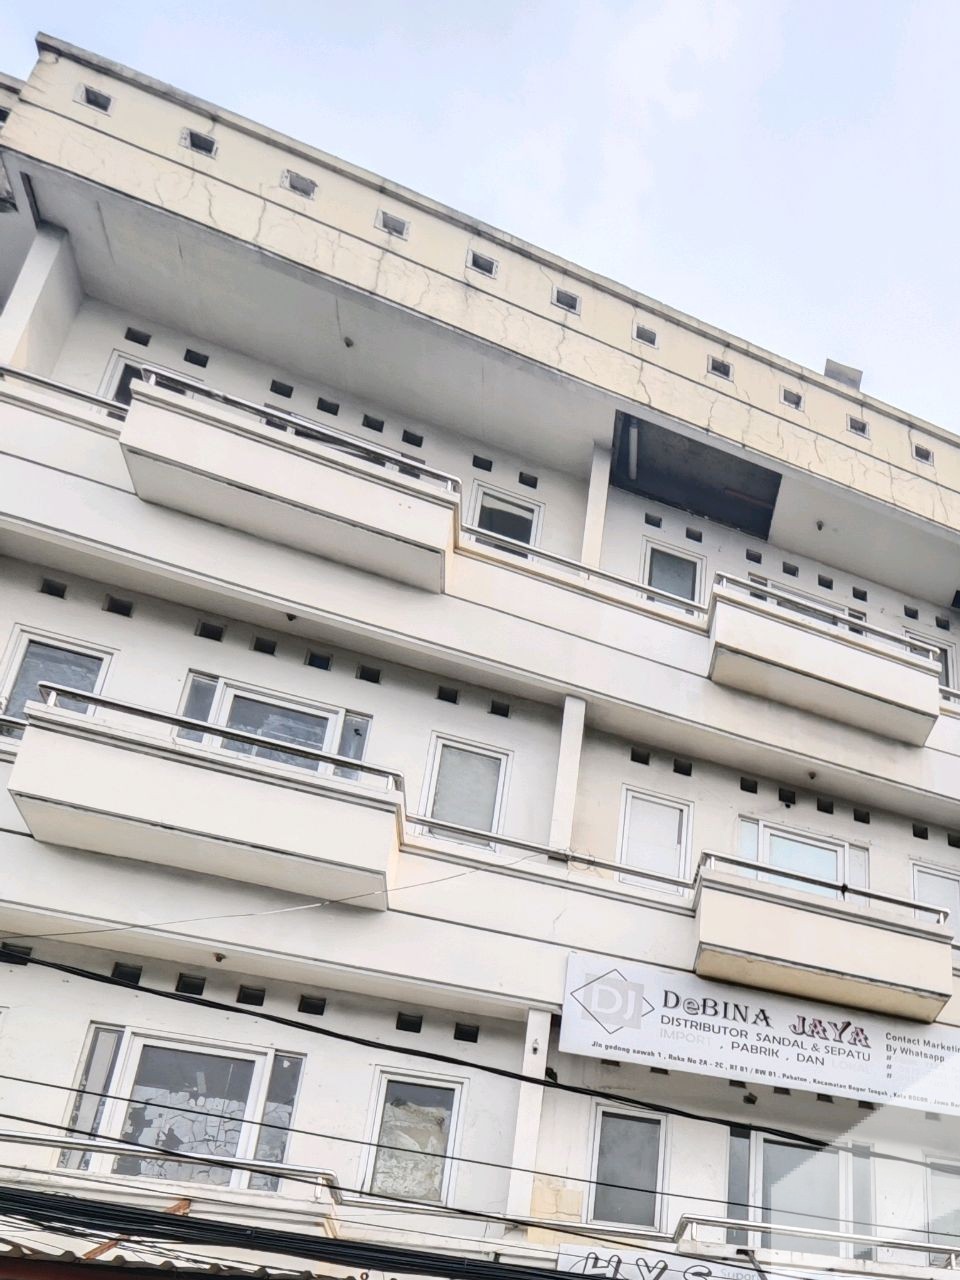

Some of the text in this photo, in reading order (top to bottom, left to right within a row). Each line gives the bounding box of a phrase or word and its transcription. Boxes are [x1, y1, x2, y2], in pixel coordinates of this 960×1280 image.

[660, 1015, 871, 1062] DISTRIBUTOR SANDAL & SEPATU
[788, 1013, 872, 1049] JAYA
[885, 1031, 920, 1046] Contact
[731, 1041, 780, 1058] PABRIK
[796, 1052, 825, 1066] DAN
[885, 1043, 945, 1063] By Whatsapp
